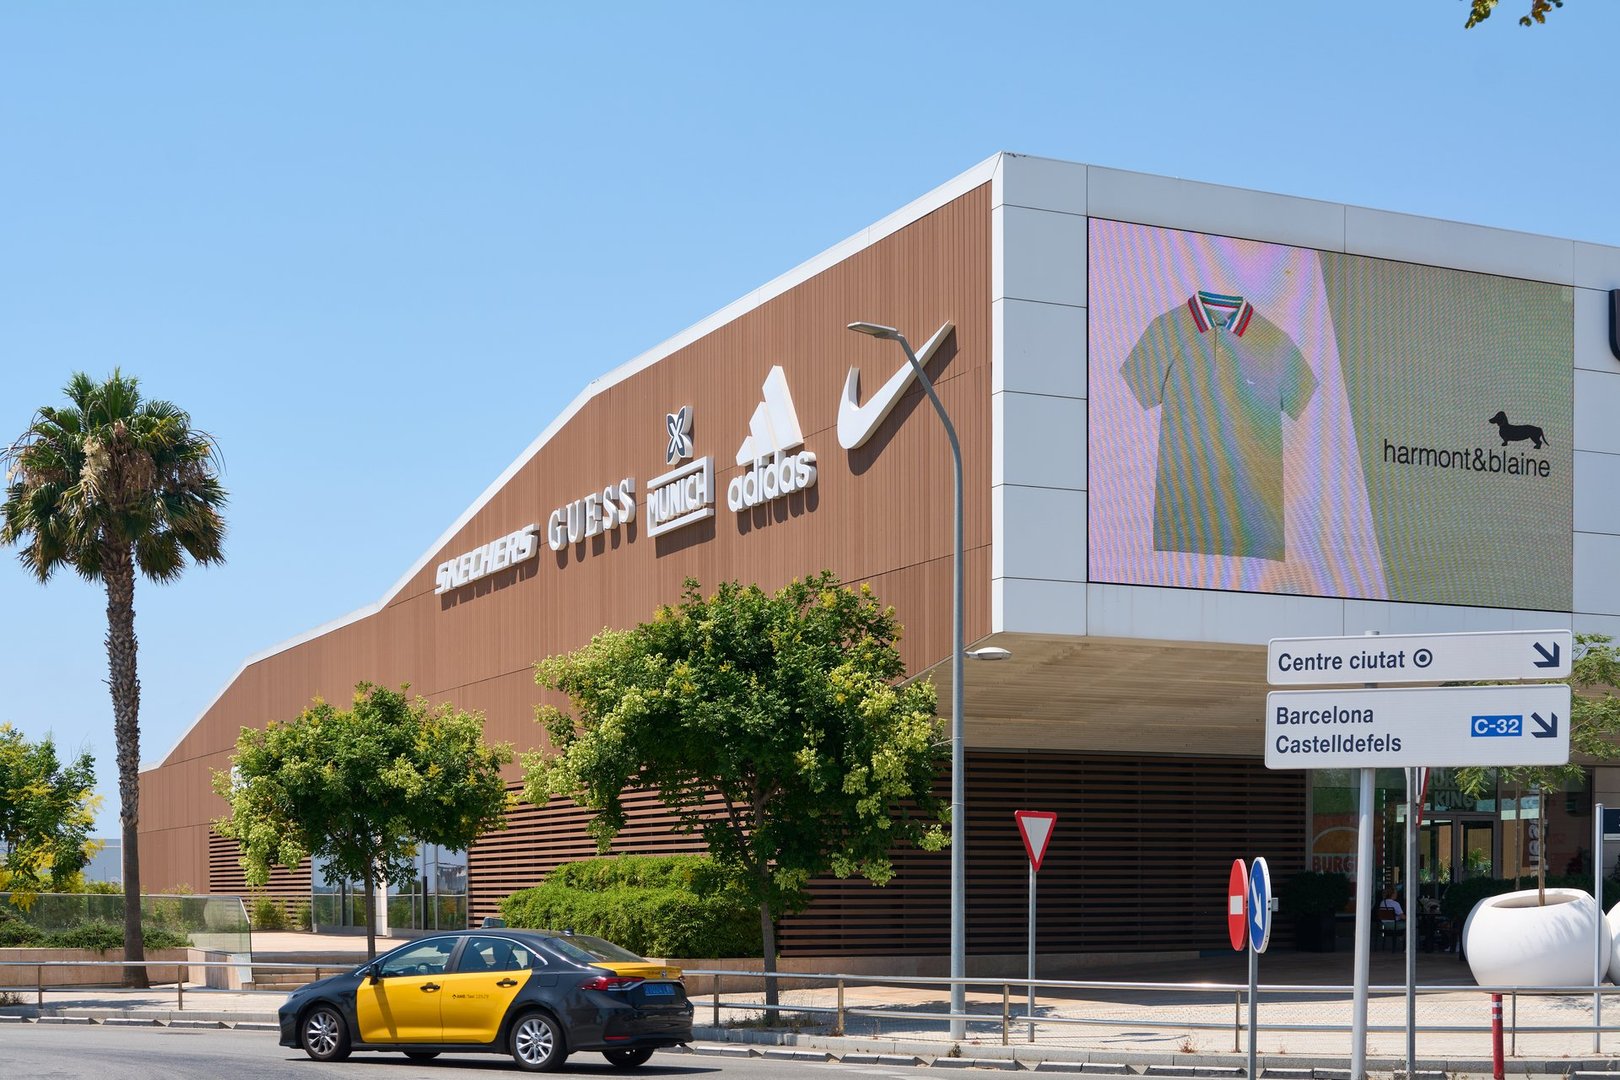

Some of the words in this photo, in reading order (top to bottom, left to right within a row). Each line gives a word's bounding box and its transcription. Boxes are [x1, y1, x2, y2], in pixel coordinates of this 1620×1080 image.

[1384, 439, 1550, 477] harmont&blaine
[647, 471, 707, 524] MUNICH
[727, 450, 817, 513] adidas
[548, 478, 636, 551] GUESS
[434, 523, 540, 595] SKECHERS
[1278, 653, 1343, 672] Centre
[1350, 650, 1406, 669] ciutat
[1276, 706, 1374, 725] Barcelona
[1474, 718, 1520, 734] C-32
[1276, 733, 1402, 754] Castelldefels
